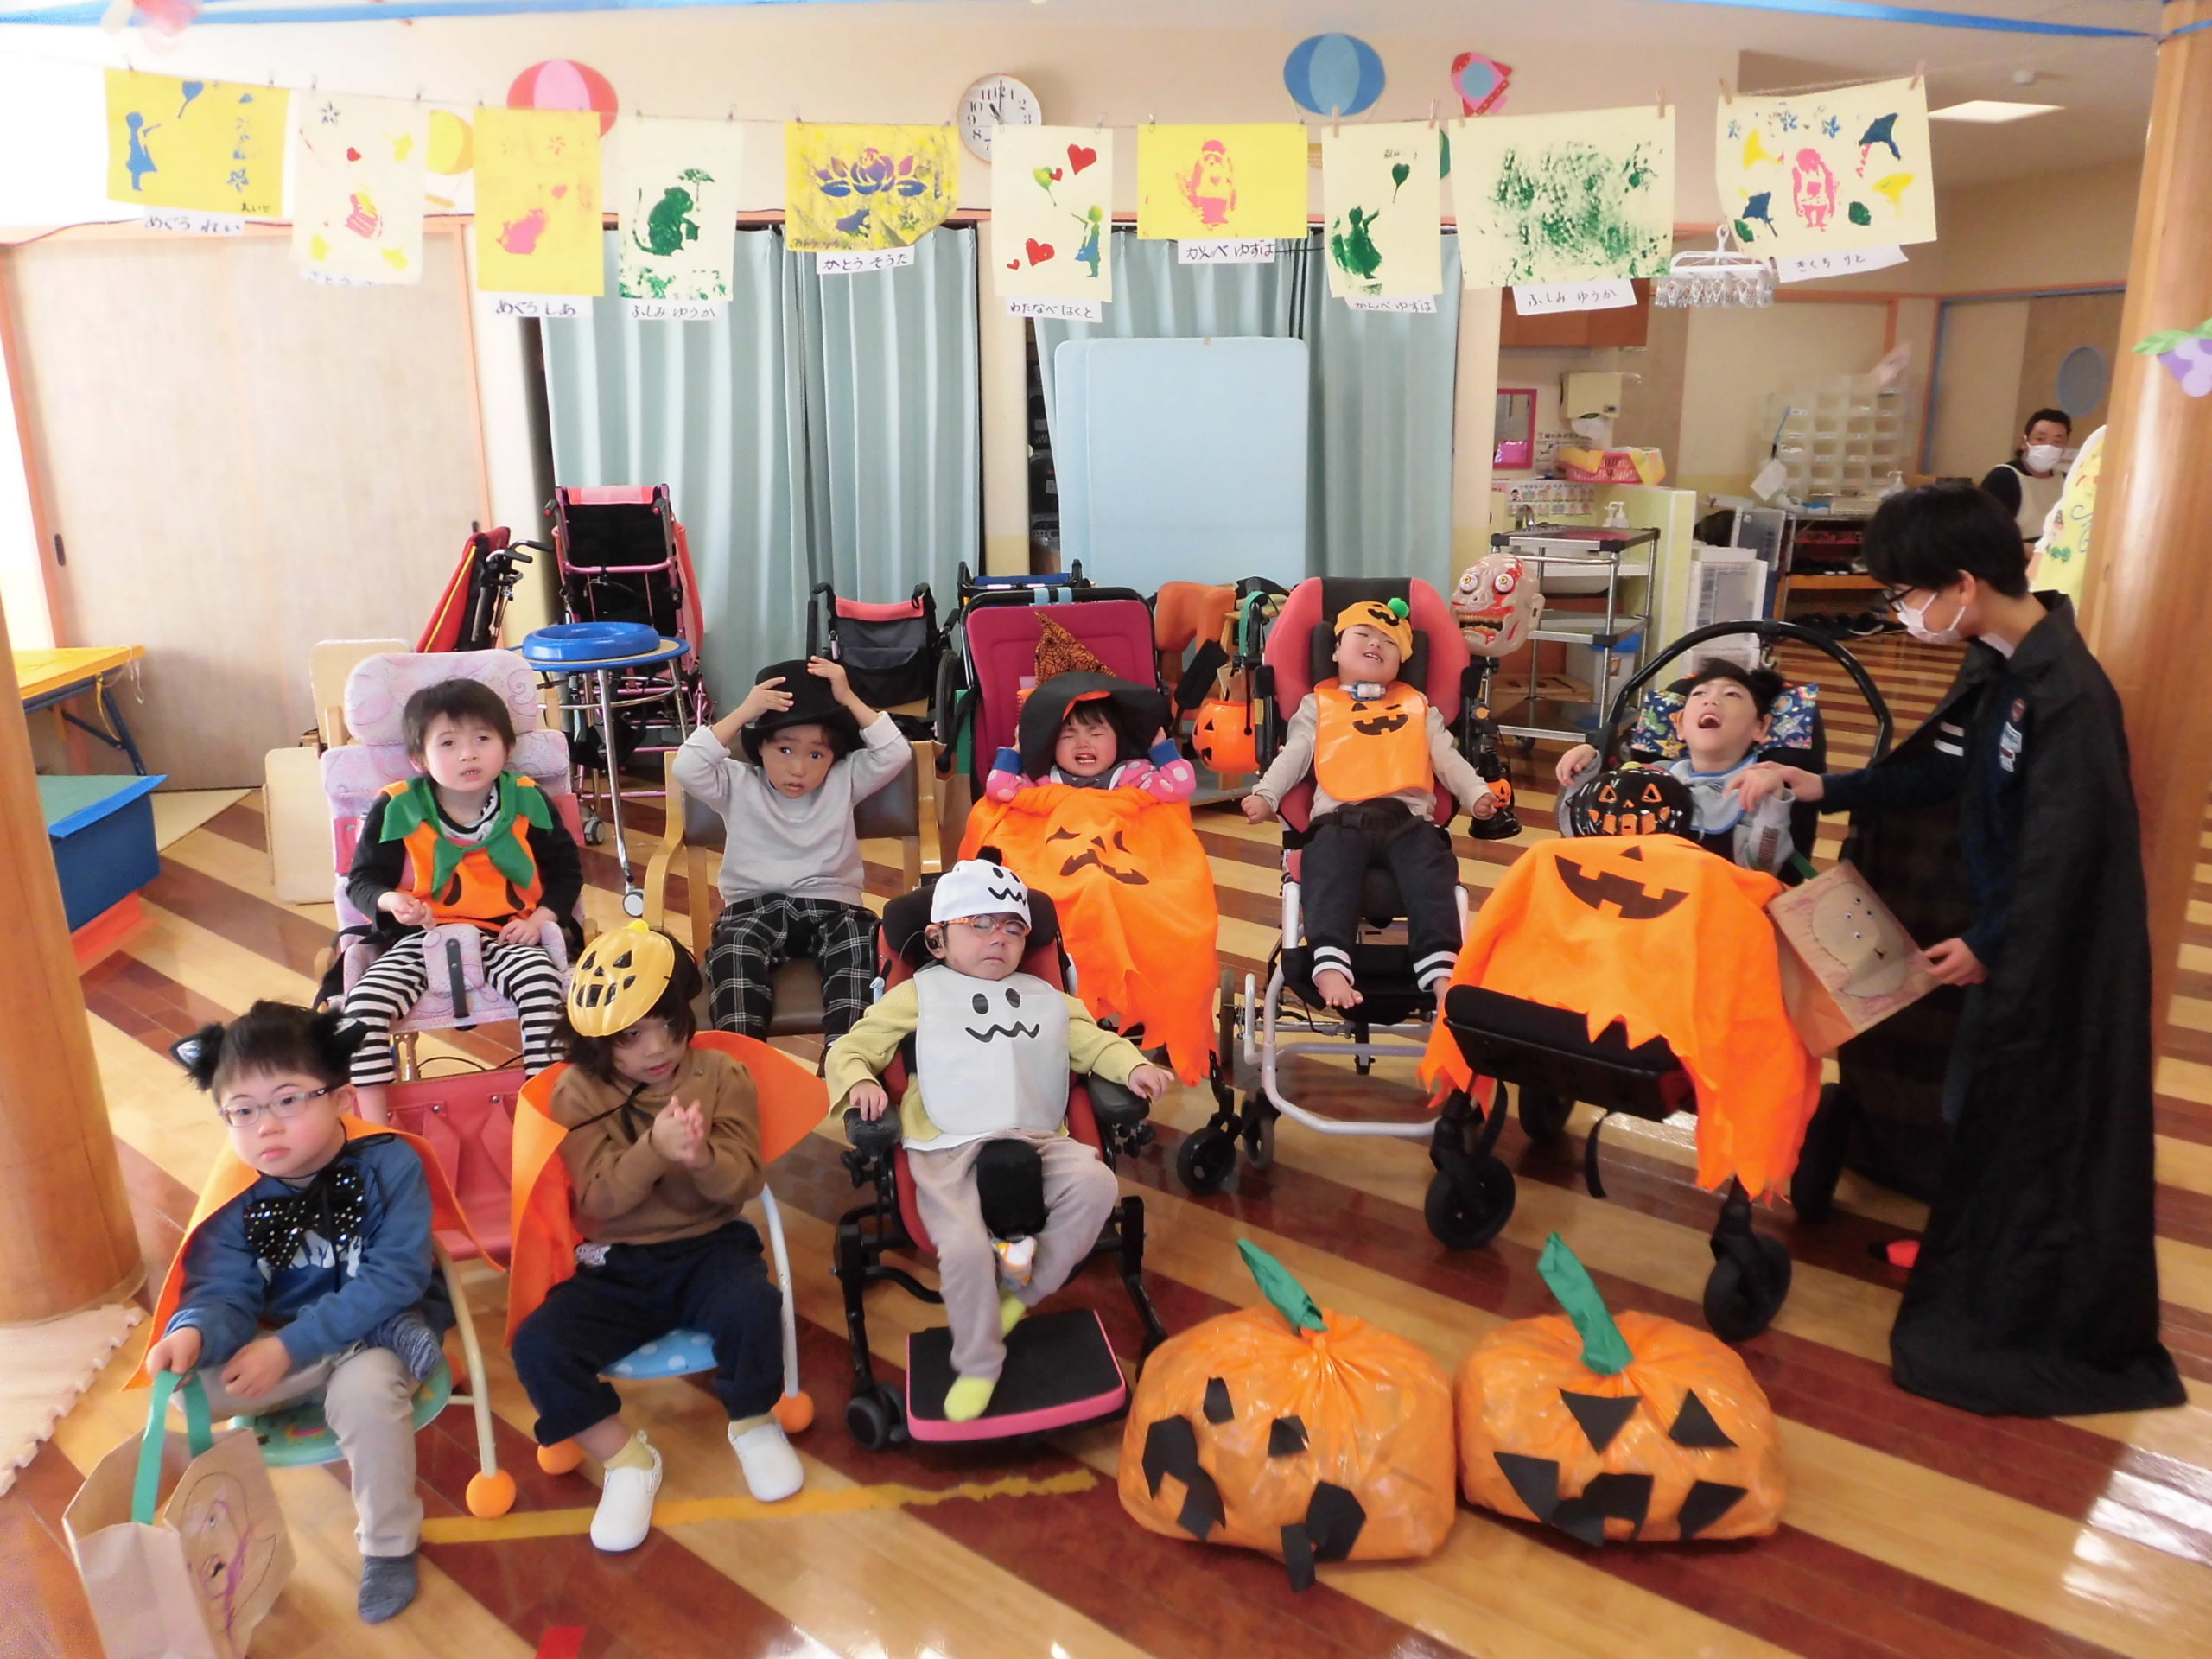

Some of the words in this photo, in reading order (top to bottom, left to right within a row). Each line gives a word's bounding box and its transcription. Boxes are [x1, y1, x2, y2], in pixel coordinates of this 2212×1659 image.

[981, 89, 991, 101] 11
[969, 100, 983, 113] 10
[967, 114, 976, 125] 9
[1023, 113, 1032, 124] 3
[972, 129, 982, 140] 8
[1186, 245, 1229, 260] かんべ
[1234, 239, 1275, 258] ゆずは
[823, 257, 863, 271] かとう
[869, 253, 908, 270] そうた
[1796, 257, 1831, 272] きくち
[1844, 255, 1866, 266] りと
[1529, 292, 1566, 307] ふしみ
[1577, 289, 1618, 303] ゆうか
[631, 304, 665, 318] ふしみ
[1010, 301, 1058, 315] わたなべ
[1061, 304, 1093, 319] はくと
